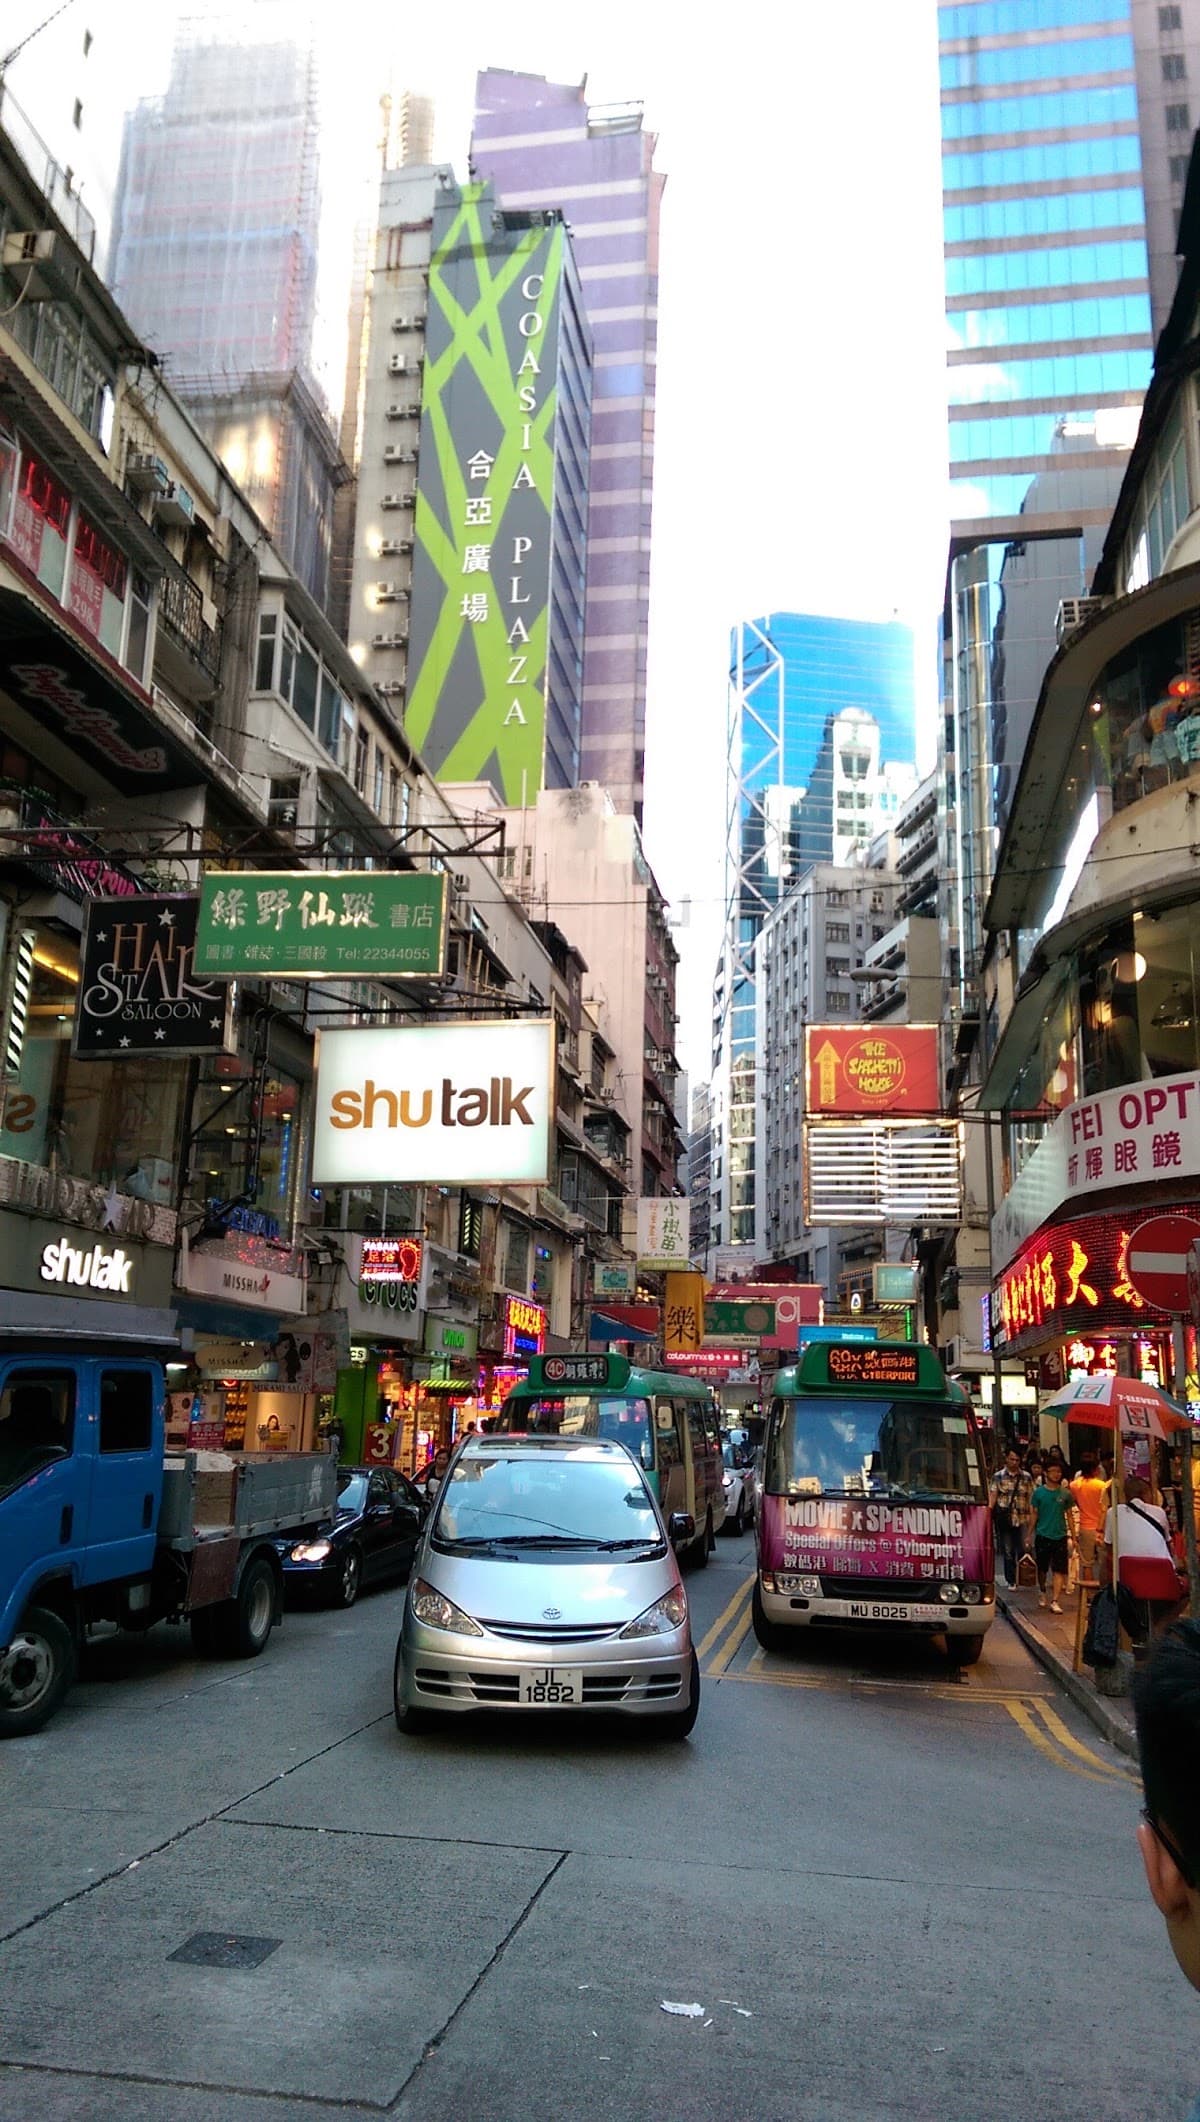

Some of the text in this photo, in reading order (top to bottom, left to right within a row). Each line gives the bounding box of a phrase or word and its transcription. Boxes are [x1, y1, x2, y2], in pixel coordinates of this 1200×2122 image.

[502, 273, 544, 726] COASIA PLAZA
[459, 449, 495, 625] 合亞廣場
[210, 888, 436, 931] 綠野仙蹤 書店
[364, 946, 431, 960] 22344055
[121, 1002, 202, 1020] SALOON
[859, 1041, 887, 1056] THE
[858, 1076, 894, 1093] HOUSE
[330, 1077, 535, 1129] shu talk
[1071, 1082, 1200, 1144] FEI OPT
[660, 1200, 683, 1251] 小樹苗
[223, 1273, 258, 1293] MISSHA
[666, 1306, 696, 1343] 樂
[548, 1362, 565, 1377] 4C
[785, 1499, 848, 1530] MOVIE
[866, 1503, 963, 1538] SPENDING
[785, 1530, 963, 1559] Special Offers @ Cyberport
[851, 1604, 868, 1617] MU
[872, 1606, 908, 1618] 8025
[536, 1668, 563, 1686] JL
[526, 1686, 574, 1702] 1882
